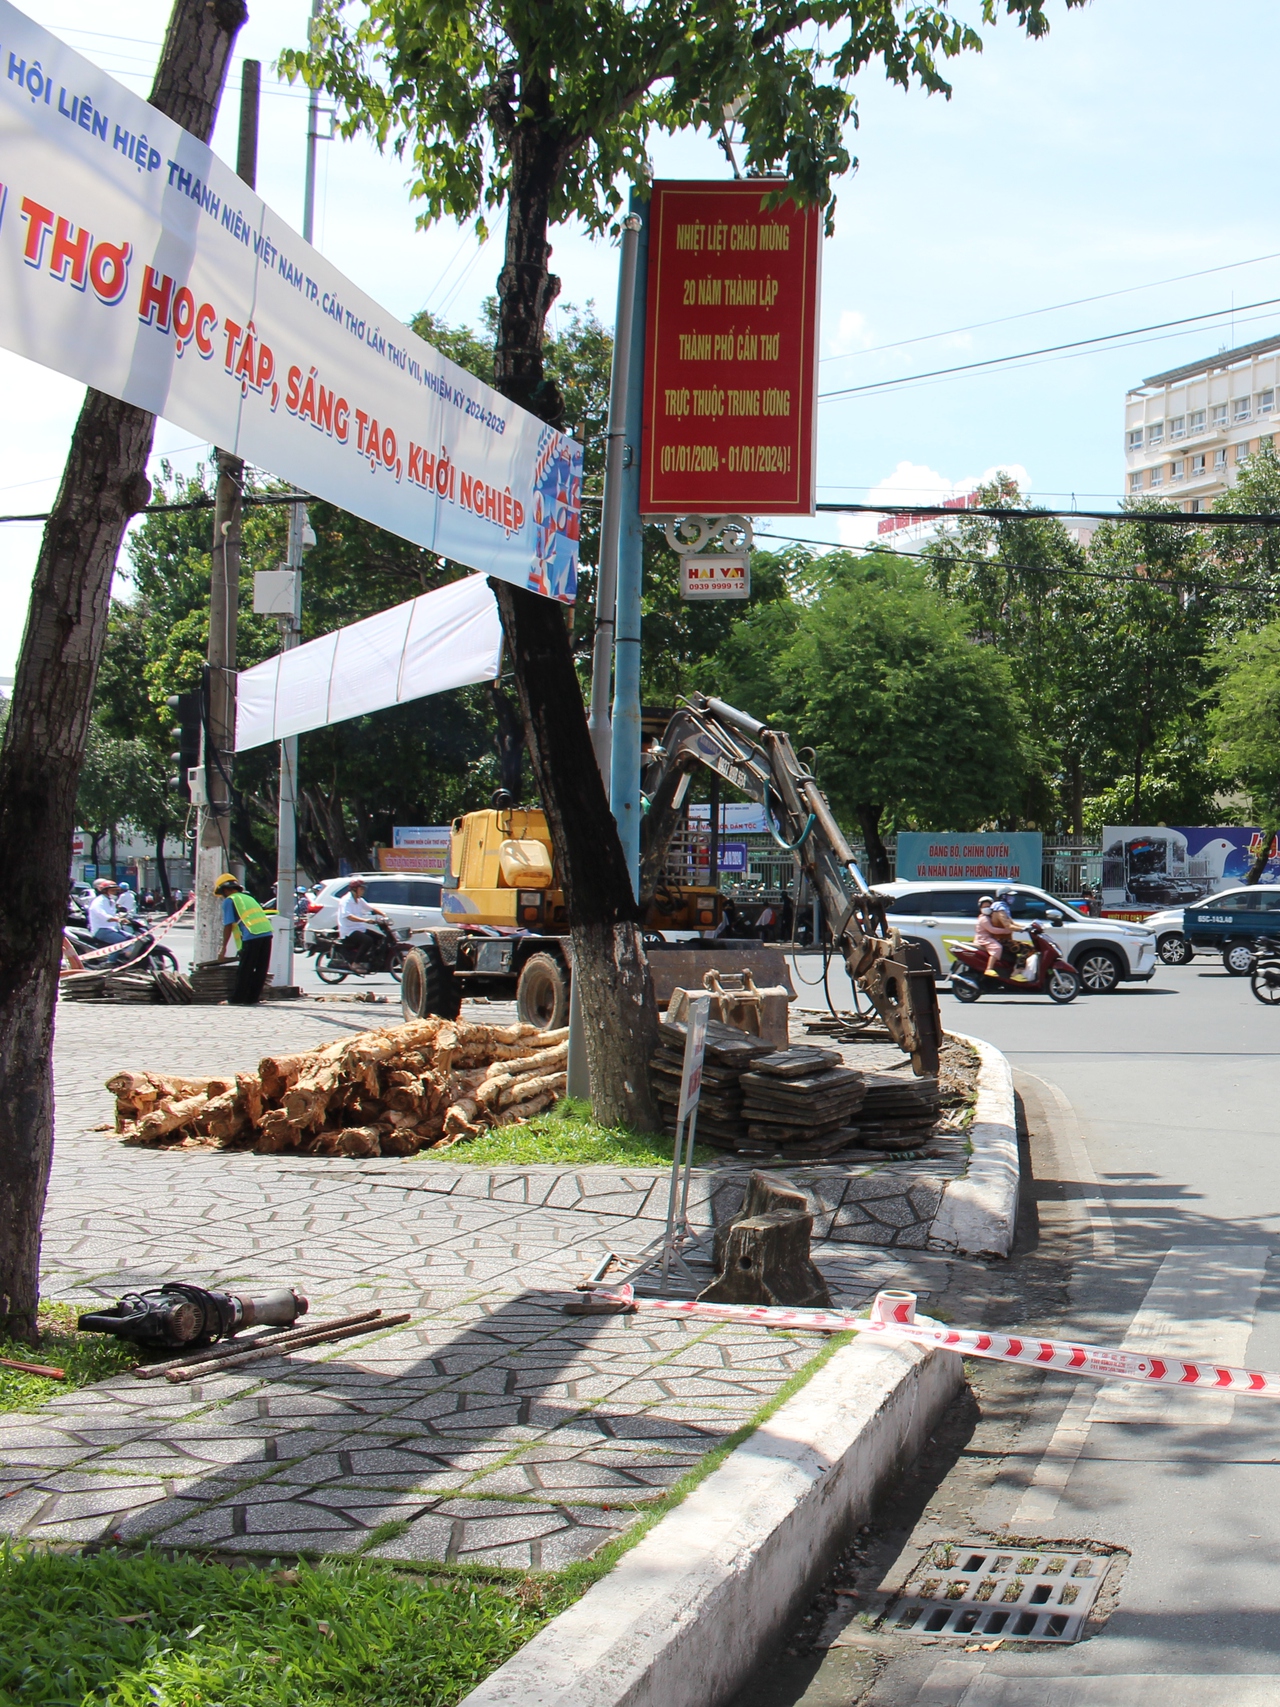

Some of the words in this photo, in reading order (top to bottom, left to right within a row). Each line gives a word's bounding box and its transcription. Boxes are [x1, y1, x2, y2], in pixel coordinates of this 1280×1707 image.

[8, 51, 53, 105] HỘI
[58, 87, 108, 142] LIÊN
[113, 124, 162, 173] HIỆP
[167, 159, 221, 220] THANH
[221, 210, 251, 247] NIÊN
[253, 229, 278, 269] VIỆT
[279, 254, 303, 292] NAM
[305, 276, 320, 306] TP.
[322, 291, 343, 325] CẦN
[345, 310, 366, 340] THƠ
[366, 326, 386, 357] LẦN
[387, 342, 407, 370] THỨ
[408, 357, 422, 386] VII,
[423, 371, 452, 403] NHIỆM
[453, 386, 465, 408] KỲ
[465, 398, 506, 436] 2024-2029
[676, 219, 706, 256] NHIỆT
[707, 219, 728, 256] LIỆT
[730, 219, 757, 251] CHÀO
[759, 219, 790, 251] MỪNG
[683, 279, 696, 305] 20
[698, 273, 722, 305] NĂM
[724, 274, 757, 306] THÀNH
[759, 273, 779, 311] LẬP
[679, 328, 712, 360] THÀNH
[714, 325, 736, 360] PHỐ
[737, 325, 758, 361] CẦN
[760, 332, 780, 361] THƠ
[20, 196, 133, 307] THƠ
[138, 264, 218, 360] HỌC
[223, 317, 280, 413] TẬP,
[285, 365, 351, 445] SÁNG
[355, 408, 403, 484] TẠO,
[407, 441, 455, 501] KHỞI
[459, 474, 525, 540] NGHIỆP
[665, 387, 690, 422] TRỰC
[692, 384, 725, 422] THUỘC
[727, 389, 760, 416] TRUNG
[762, 387, 790, 416] ƯƠNG
[661, 445, 719, 474] (01/01/2004
[728, 445, 791, 475] 01/01/2024)!
[917, 862, 926, 876] VÀ
[928, 863, 946, 877] NHÂN
[949, 863, 963, 877] DÂN
[965, 863, 992, 877] PHƯỜNG
[995, 863, 1008, 877] TÂN
[1010, 865, 1019, 877] AN
[929, 842, 948, 857] ĐẢNG
[950, 843, 961, 860] BỘ,
[963, 843, 984, 857] CHÍNH
[986, 842, 1009, 857] QUYỀN
